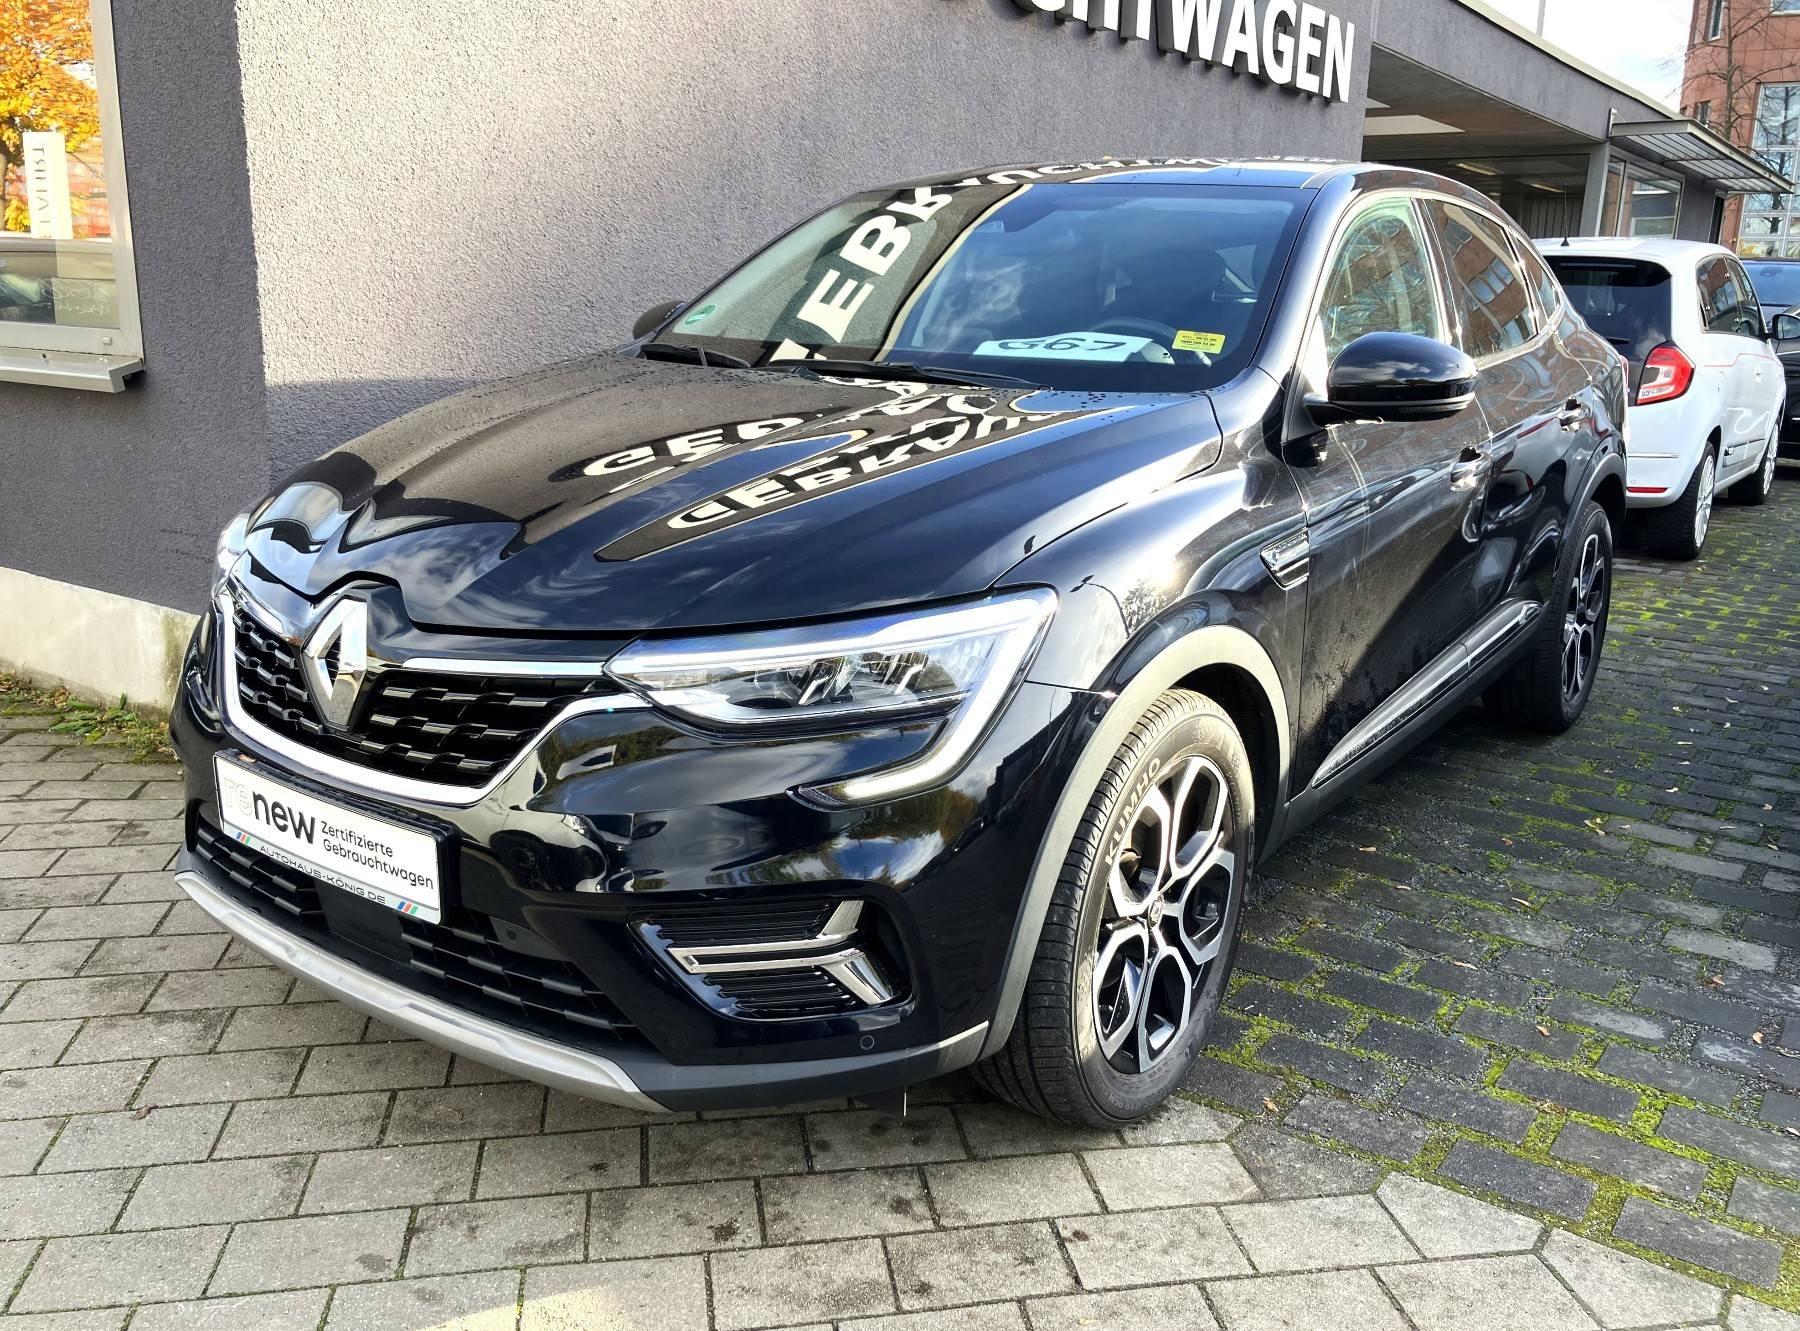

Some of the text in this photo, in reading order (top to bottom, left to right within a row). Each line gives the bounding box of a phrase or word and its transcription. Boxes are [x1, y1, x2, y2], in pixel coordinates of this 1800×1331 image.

[1105, 758, 1160, 866] KUMHO
[320, 820, 393, 858] Zertifizierte
[323, 838, 434, 890] Gebrauchtwagen
